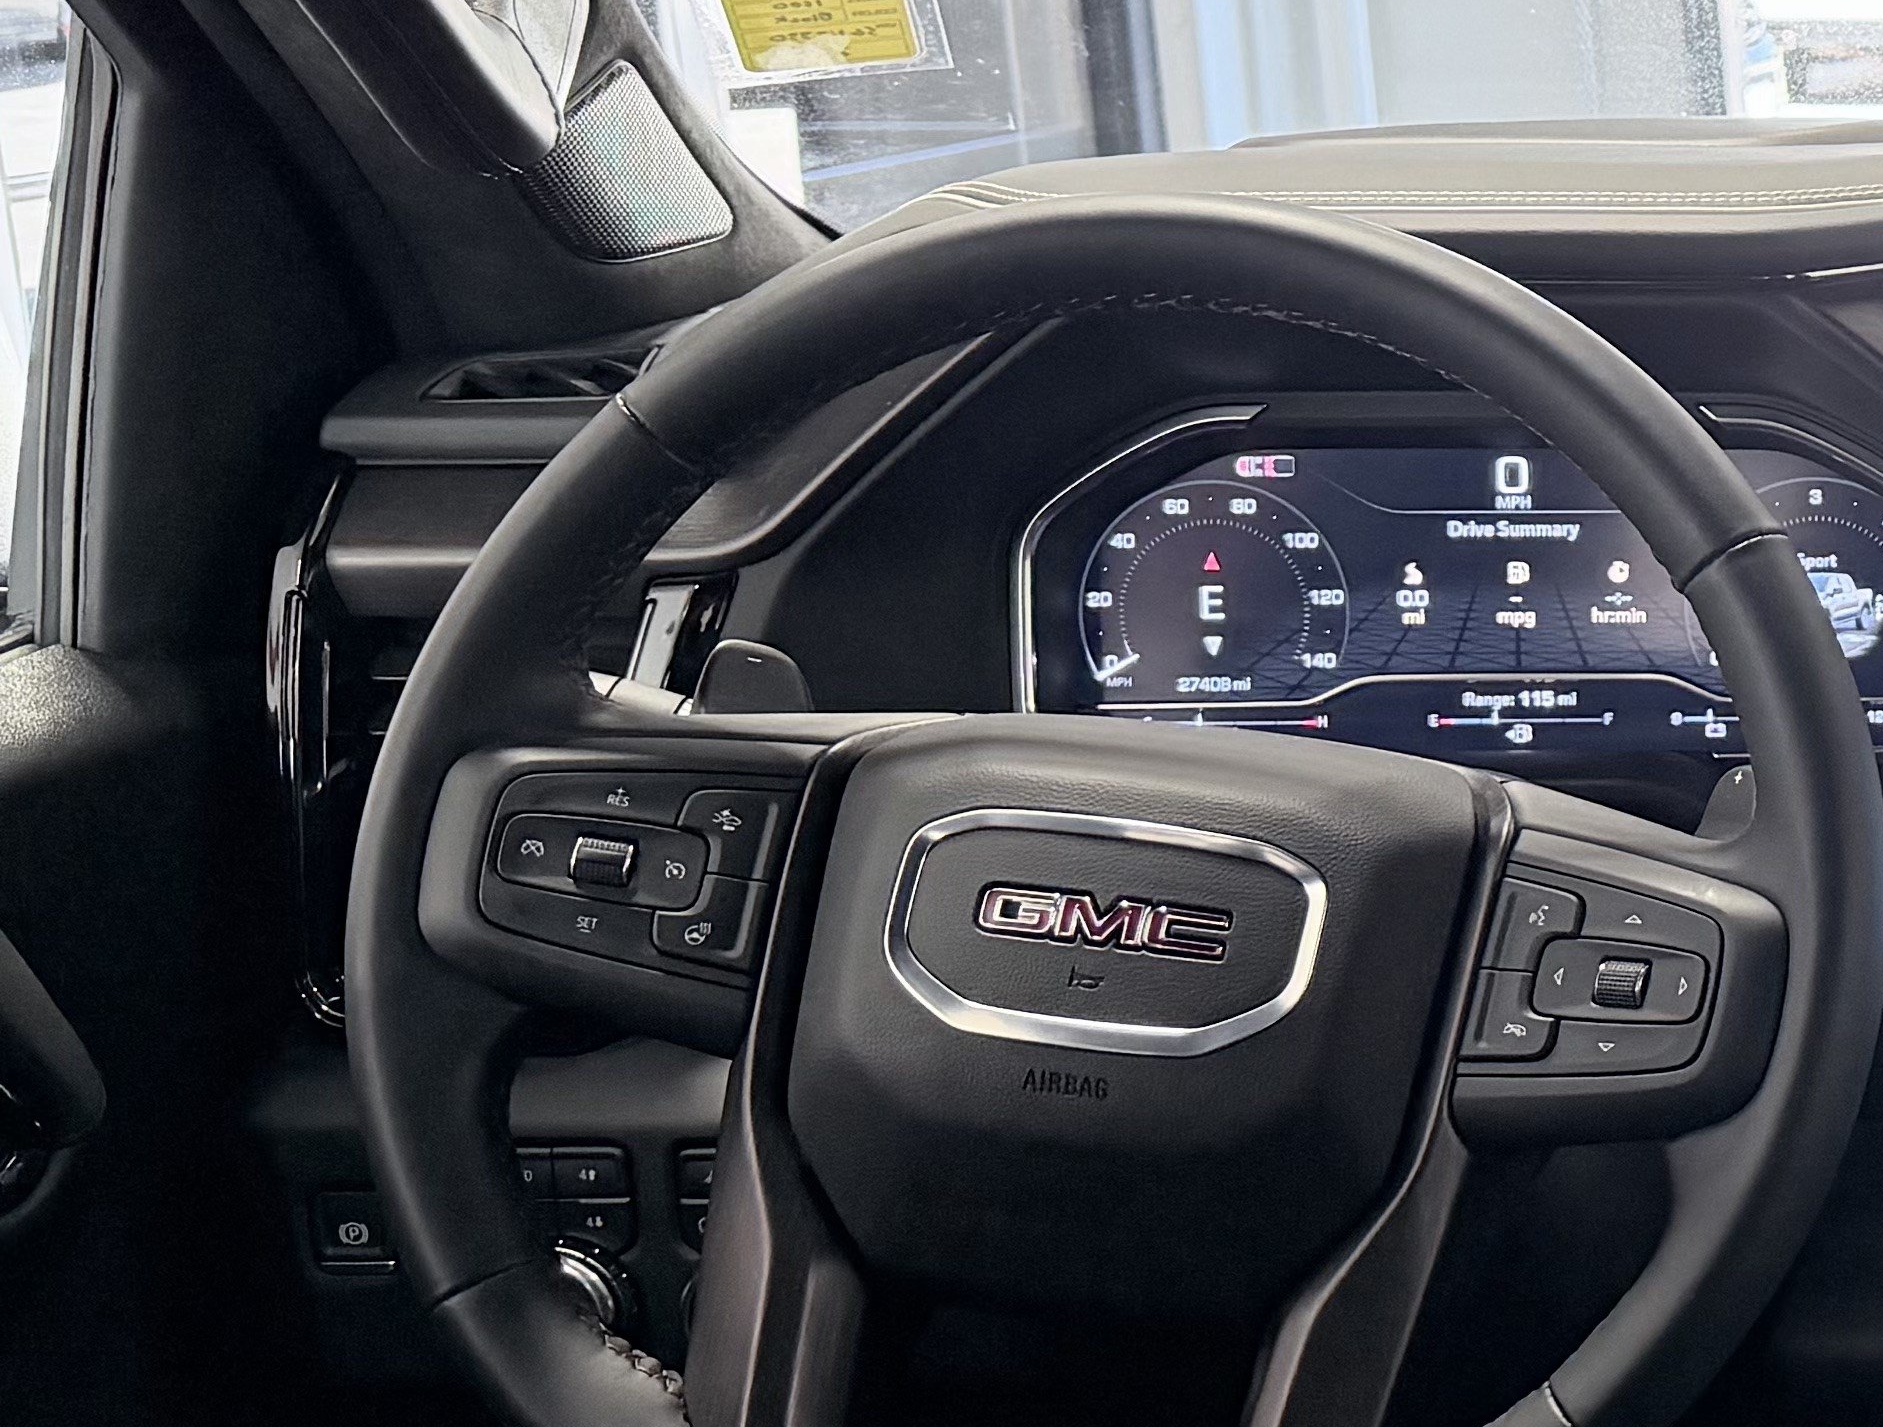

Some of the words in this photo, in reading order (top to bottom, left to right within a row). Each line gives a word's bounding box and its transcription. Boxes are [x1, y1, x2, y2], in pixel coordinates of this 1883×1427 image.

[1494, 455, 1531, 494] 0
[1494, 494, 1532, 510] MPH
[1808, 488, 1823, 506] 3
[1162, 498, 1190, 515] 60
[1229, 498, 1257, 515] 80
[1446, 520, 1495, 538] Drive
[1496, 520, 1581, 542] Summary
[1107, 532, 1136, 549] 40
[1282, 532, 1320, 549] 100
[1085, 591, 1113, 608] 20
[1198, 584, 1226, 621] E
[1309, 589, 1345, 606] 120
[1395, 589, 1430, 607] 0.0
[1401, 609, 1426, 625] mi
[1495, 609, 1537, 629] mpg
[1590, 606, 1648, 625] hr:min
[1103, 654, 1119, 670] 0
[1302, 652, 1337, 669] 140
[1106, 676, 1133, 688] MPH
[1232, 676, 1252, 691] mi
[1461, 691, 1516, 710] Range:
[1517, 689, 1555, 707] 115
[1556, 691, 1577, 707] mi
[1317, 715, 1328, 728] H
[1427, 713, 1439, 728] E
[1603, 711, 1614, 726] F
[606, 793, 631, 808] RES
[576, 915, 598, 930] SET
[974, 882, 1236, 964] GMC
[1022, 1068, 1110, 1100] AIRBAG
